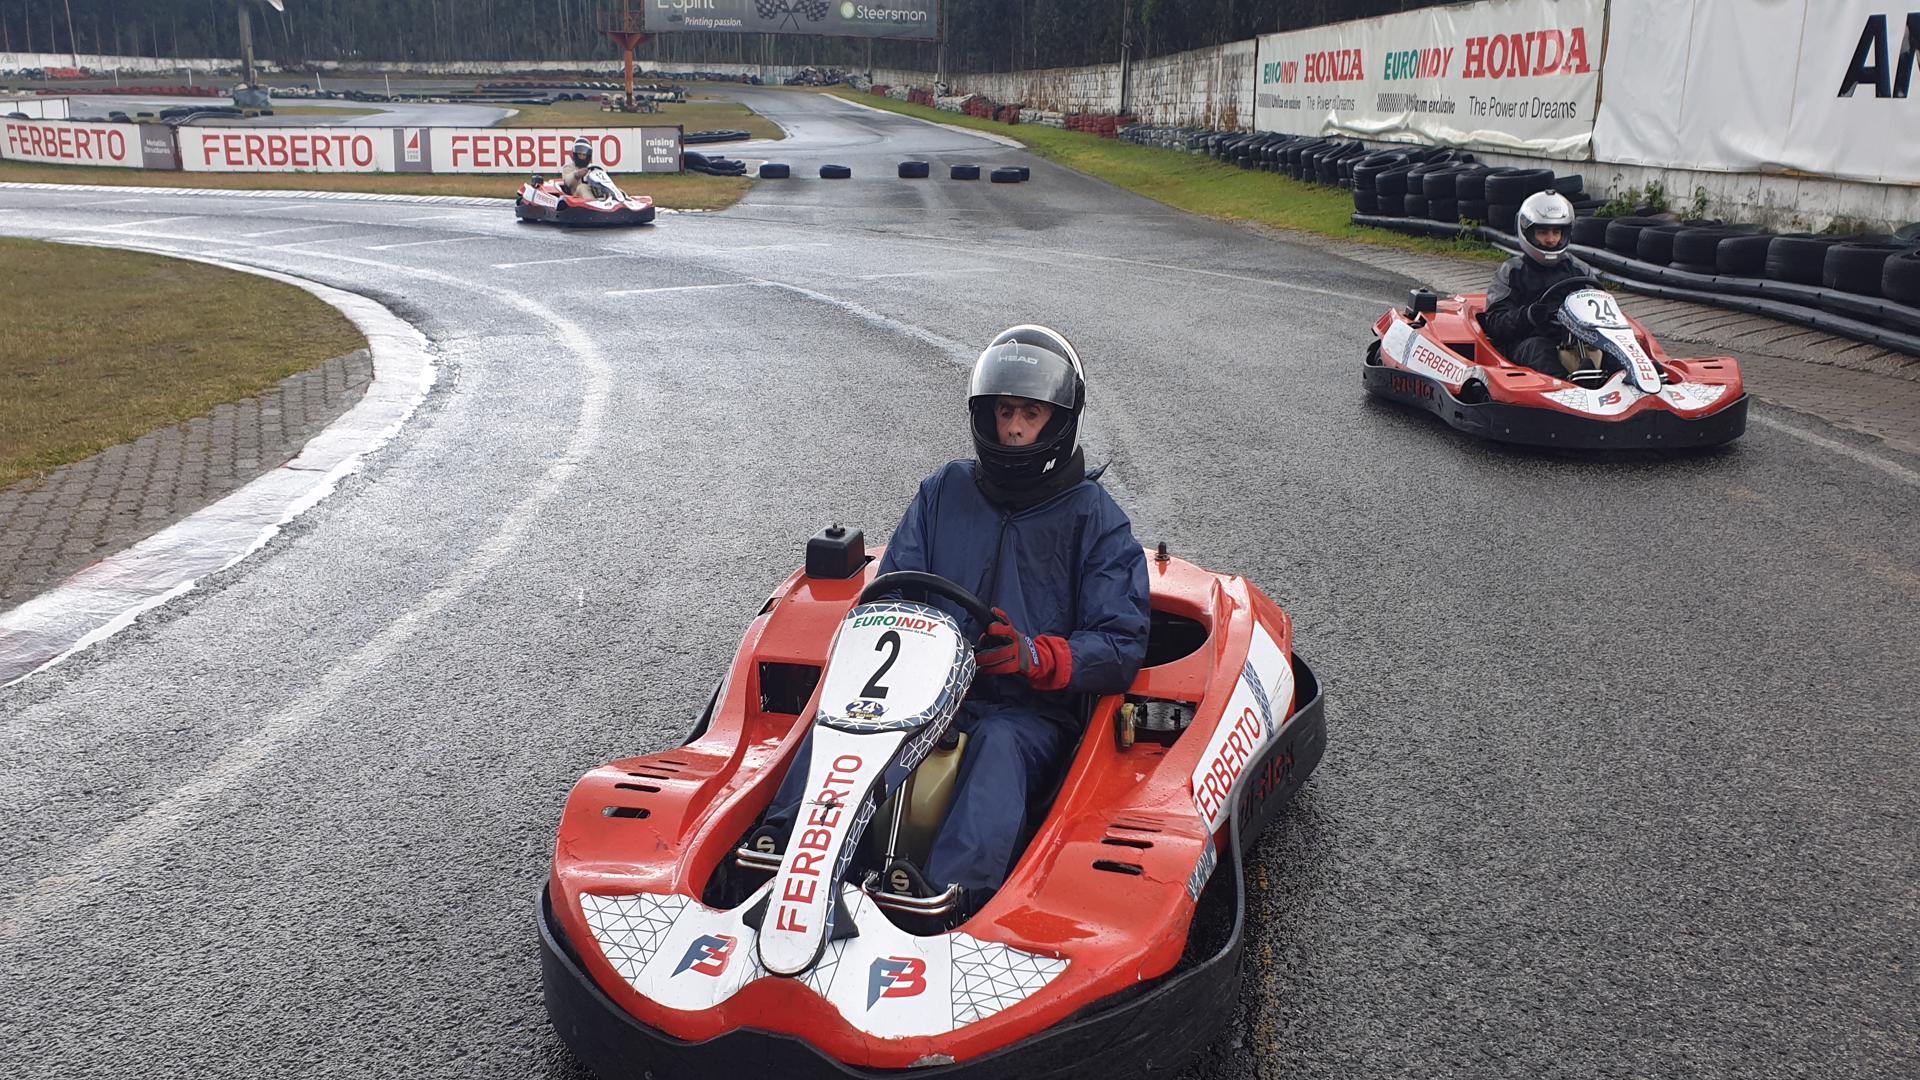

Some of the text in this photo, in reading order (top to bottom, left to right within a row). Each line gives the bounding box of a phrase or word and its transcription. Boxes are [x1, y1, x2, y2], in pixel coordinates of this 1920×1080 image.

[685, 17, 712, 29] Printing
[857, 5, 927, 21] Steersman
[1304, 48, 1364, 84] HONDA
[1384, 48, 1454, 81] EUROINDY
[1462, 27, 1590, 79] HONDA
[1469, 95, 1486, 117] The
[1489, 96, 1517, 118] Power
[1531, 96, 1576, 119] Dreams
[6, 123, 126, 161] FERBERTO
[202, 134, 373, 167] FERBERTO
[645, 138, 675, 149] raising
[653, 147, 668, 155] the
[647, 155, 674, 164] future
[1587, 299, 1617, 321] 24
[999, 355, 1039, 365] HEAD
[1412, 345, 1464, 383] FERBERTO
[852, 615, 939, 633] EUROINDY
[859, 630, 901, 699] 2
[1195, 706, 1261, 825] ERBERTO
[775, 754, 863, 934] FERBERTO
